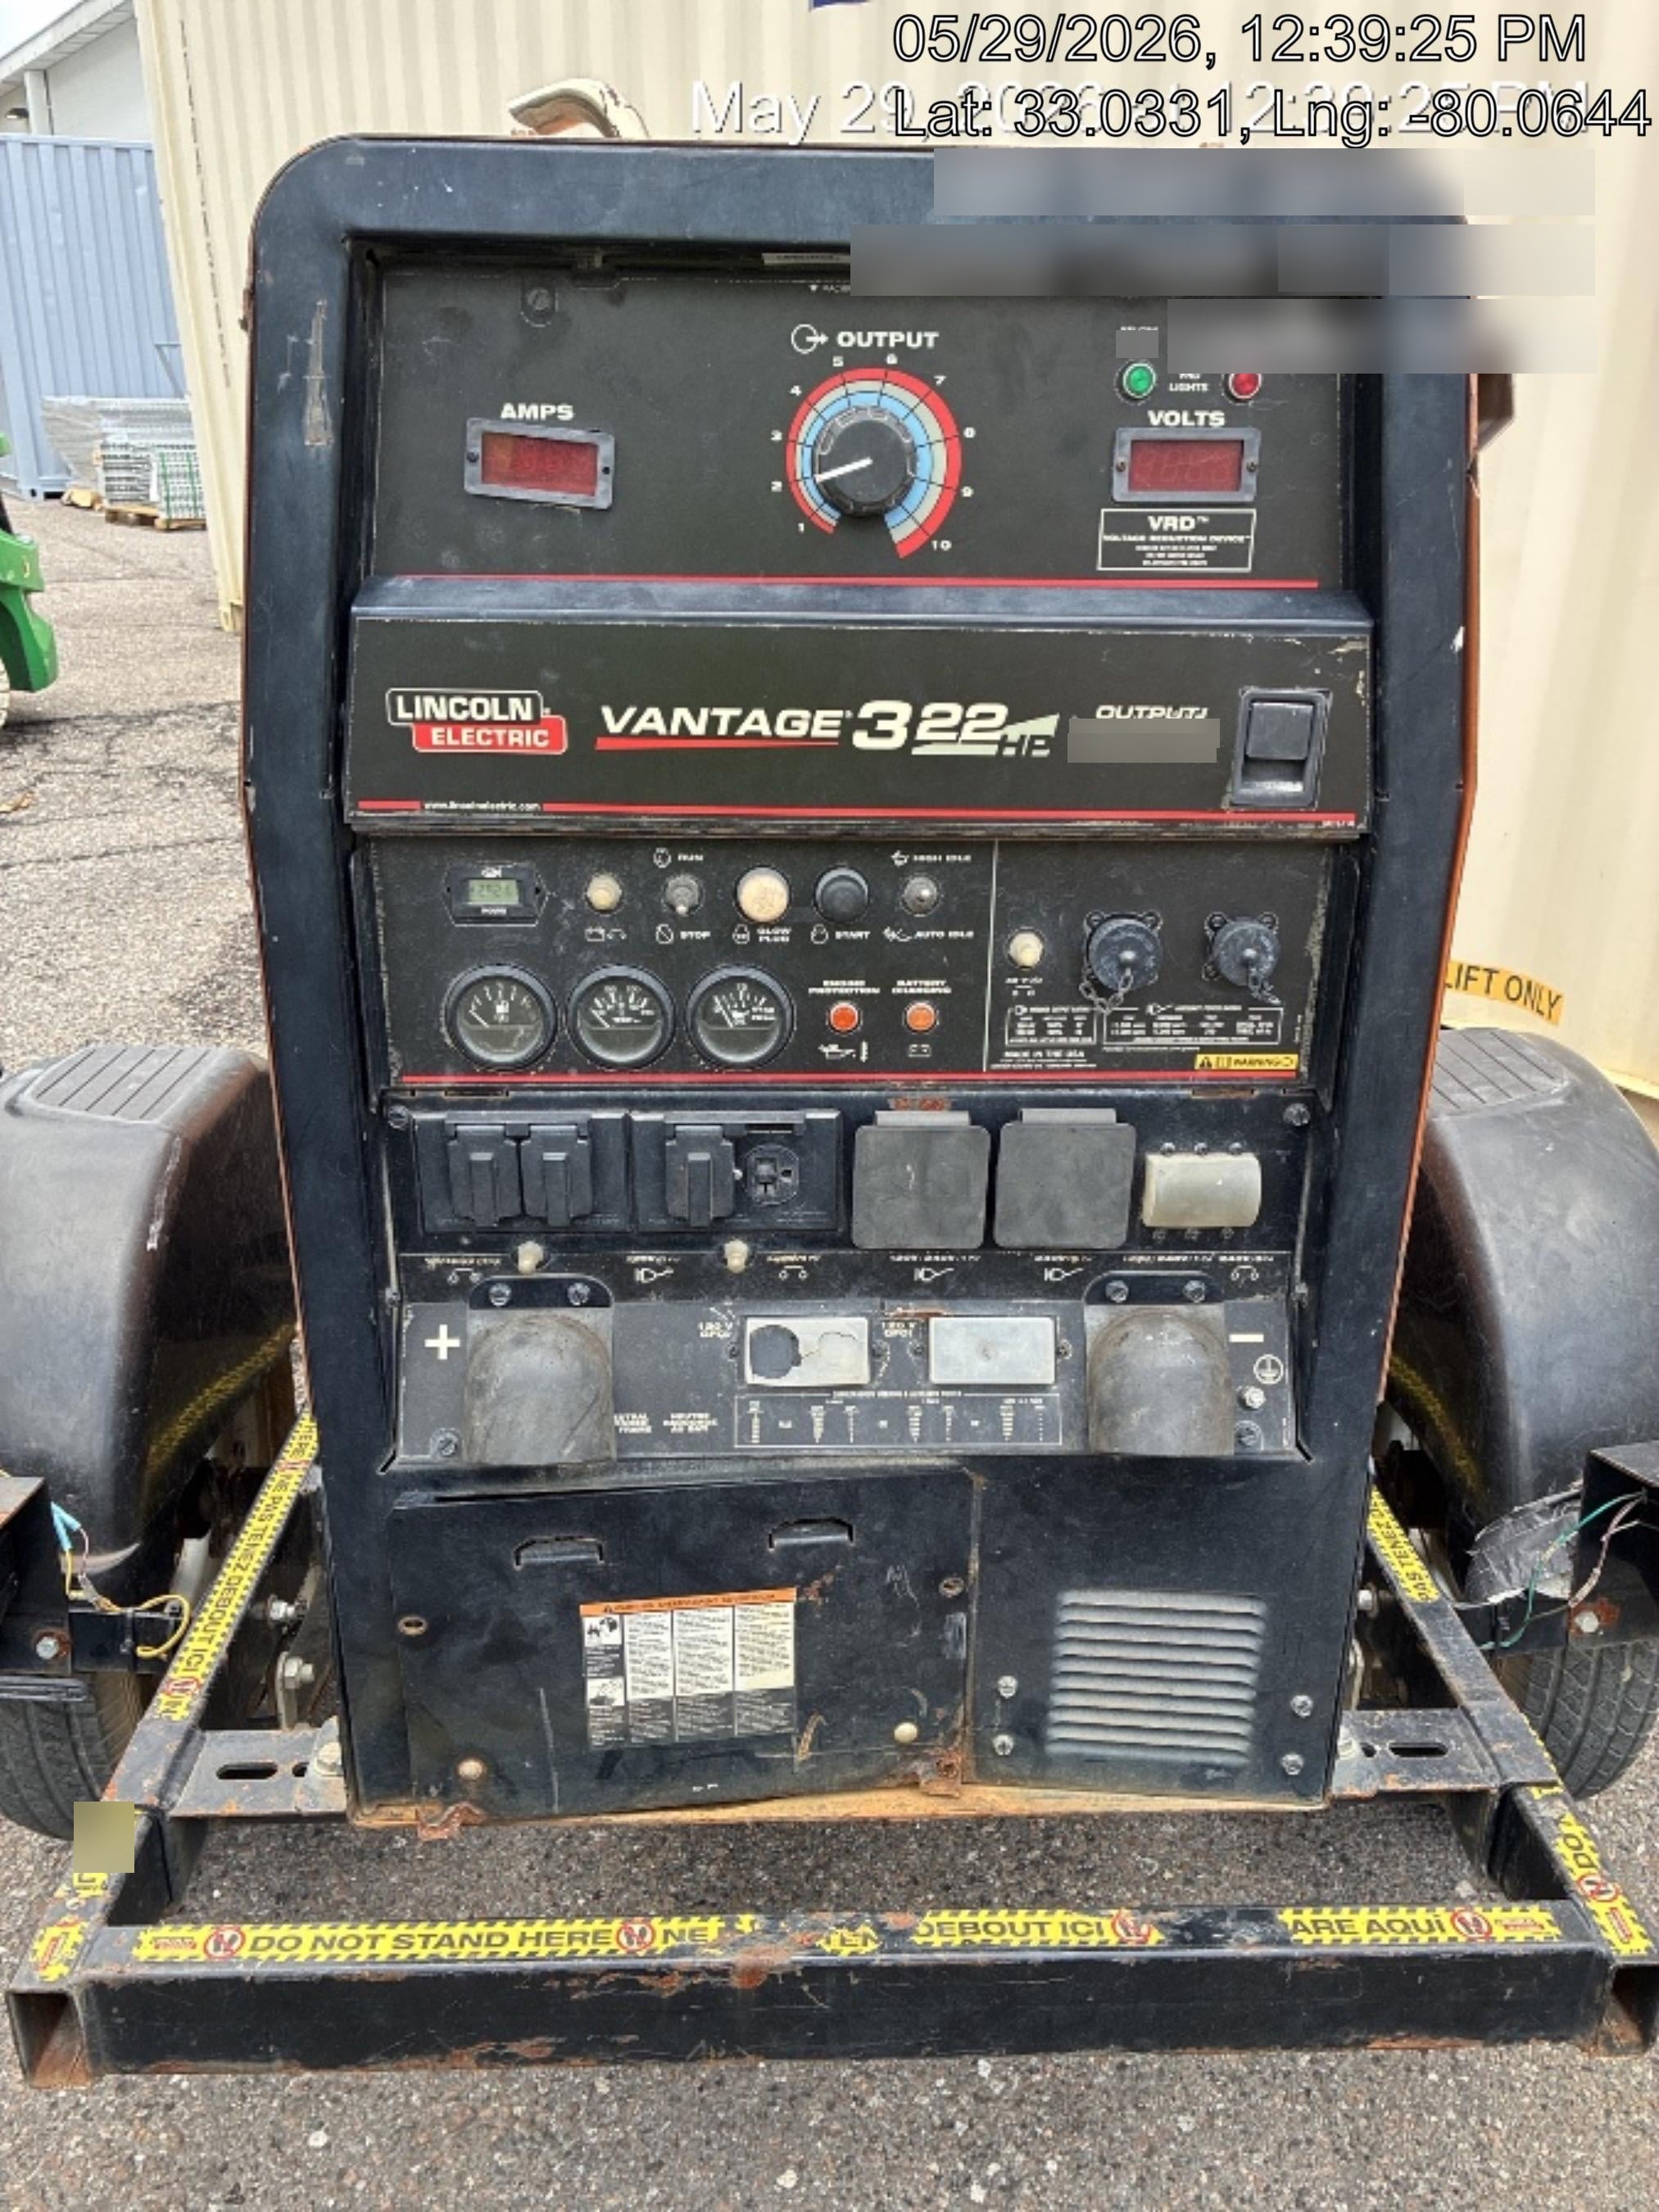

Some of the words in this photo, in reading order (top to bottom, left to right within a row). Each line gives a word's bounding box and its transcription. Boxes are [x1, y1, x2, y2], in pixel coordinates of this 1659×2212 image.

[836, 331, 941, 349] OUTPUT
[832, 356, 844, 367] 5
[886, 354, 898, 365] 6
[934, 375, 946, 386] 7
[790, 385, 802, 396] 4
[501, 402, 574, 421] AMPS
[1148, 410, 1226, 427] VOLTS
[771, 481, 782, 492] 2
[799, 523, 805, 533] 1
[932, 540, 952, 551] 10
[397, 696, 534, 722] LINCOLN
[601, 705, 844, 737] VANTAGE
[851, 700, 1009, 750] 322
[431, 726, 550, 747] ELECTRIC
[680, 931, 711, 940] STOP
[835, 931, 871, 940] START
[1445, 963, 1500, 995] IFT
[1504, 975, 1563, 1020] ONLY
[288, 1425, 315, 1457] HERE
[197, 1573, 245, 1643] DEBOUT
[180, 1646, 206, 1674] ICI
[916, 1920, 1057, 1938] DEBOUT
[1060, 1920, 1104, 1938] ICI
[1291, 1918, 1358, 1936] ARE
[249, 1934, 303, 1951] DO
[310, 1933, 386, 1951] NOT
[392, 1931, 510, 1950] STAND
[518, 1929, 614, 1947] HERE
[662, 1928, 710, 1944] NE
